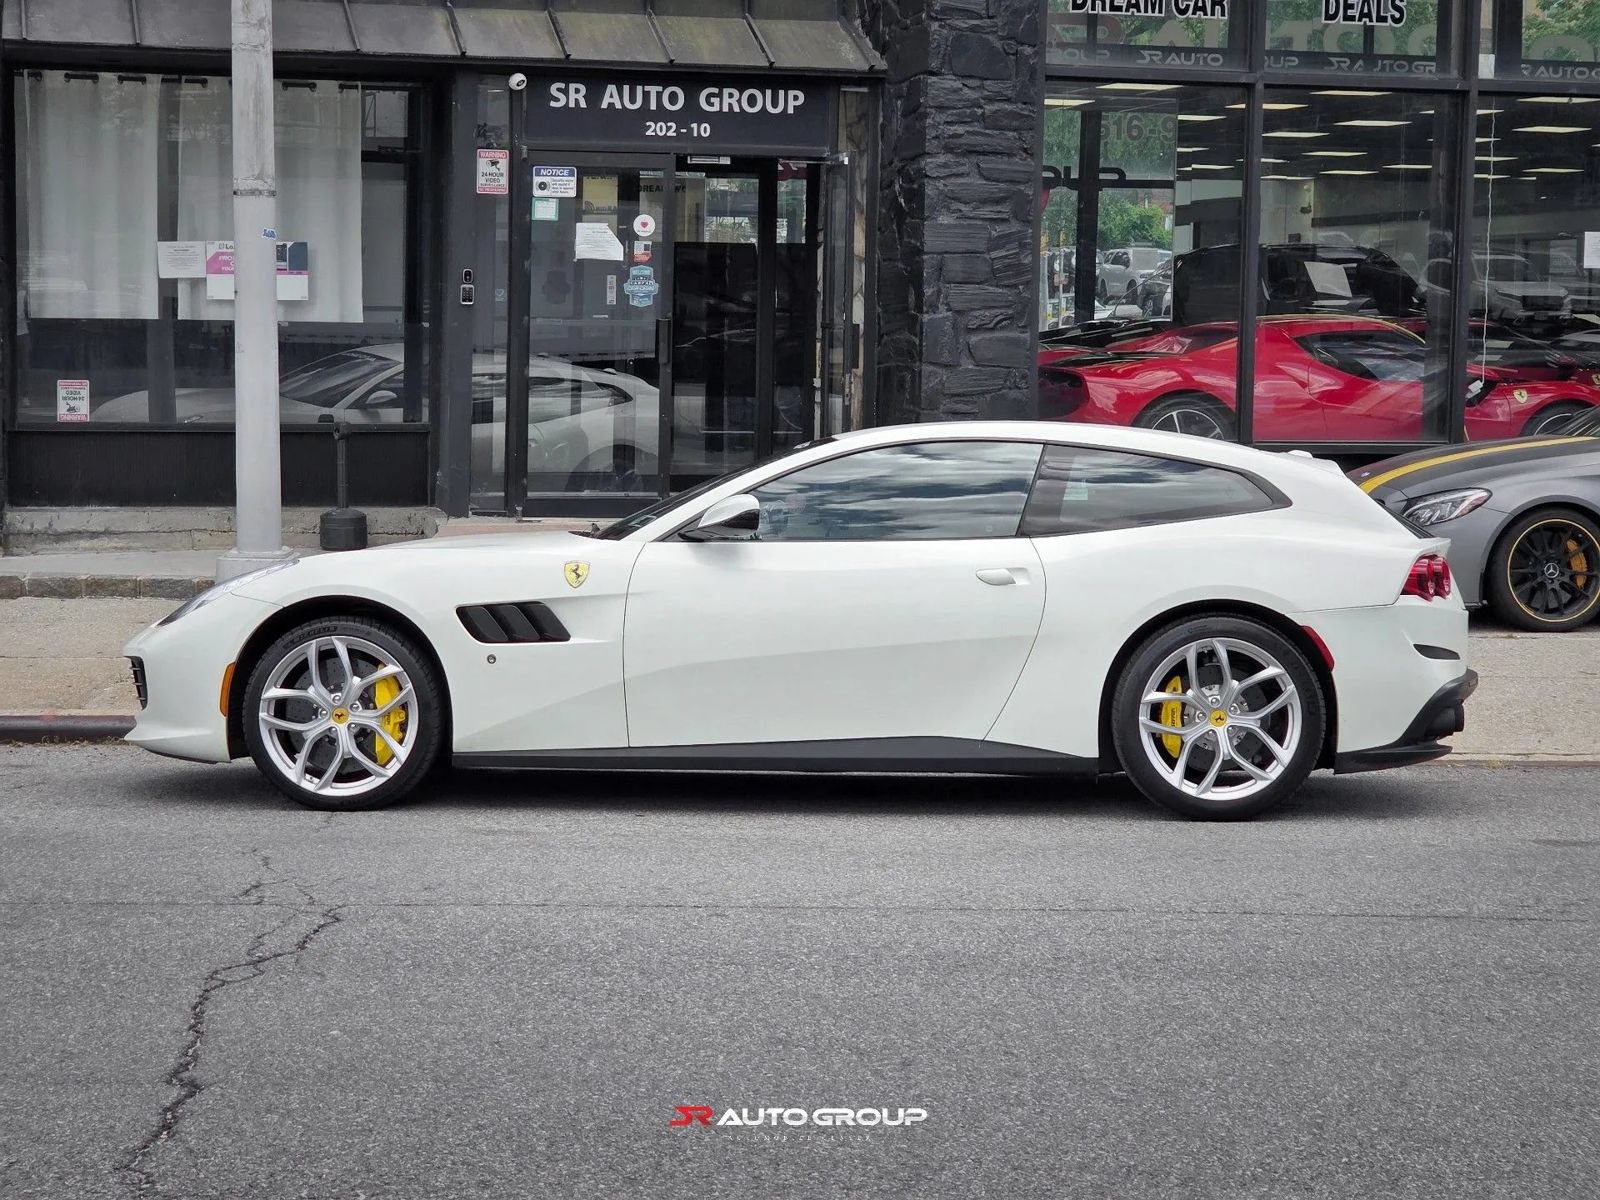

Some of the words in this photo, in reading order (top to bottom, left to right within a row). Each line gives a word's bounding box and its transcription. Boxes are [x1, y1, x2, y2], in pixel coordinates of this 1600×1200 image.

[1321, 0, 1407, 27] DEALS
[1164, 52, 1224, 67] AUTO
[549, 82, 587, 109] SR
[600, 84, 685, 111] AUTO
[699, 87, 805, 115] GROUP
